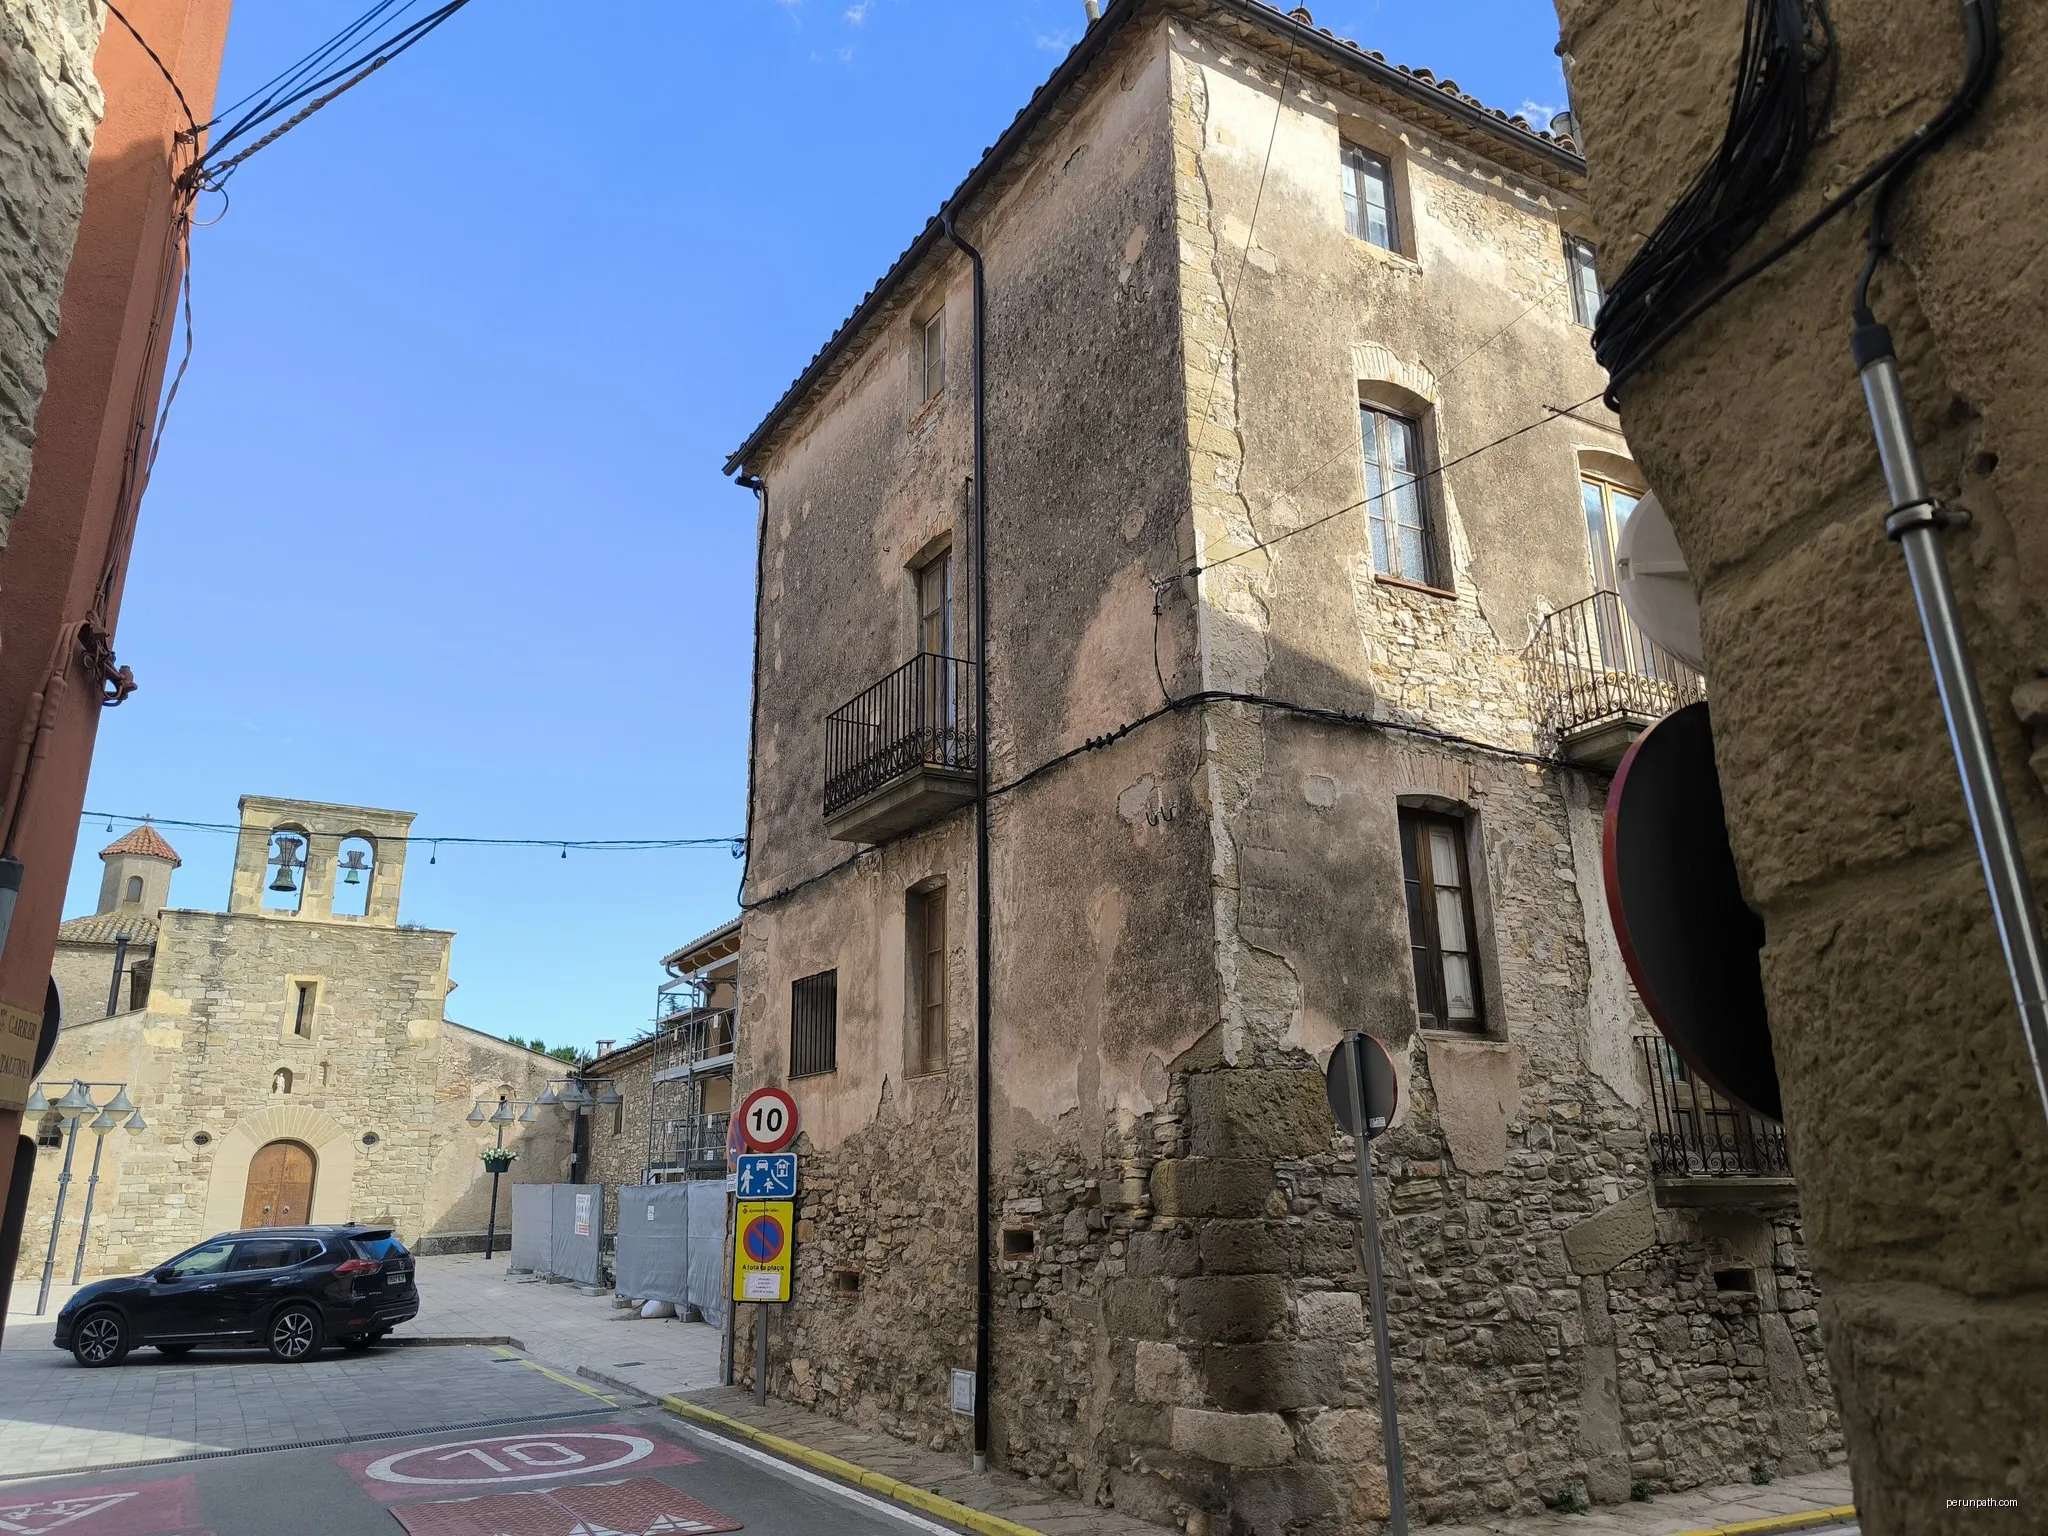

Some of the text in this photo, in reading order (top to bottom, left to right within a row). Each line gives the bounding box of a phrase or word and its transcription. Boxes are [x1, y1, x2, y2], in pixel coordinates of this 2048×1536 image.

[9, 1015, 37, 1041] CARRER
[752, 1107, 783, 1133] 10
[767, 1264, 785, 1272] plaça
[436, 1442, 586, 1473] 10
